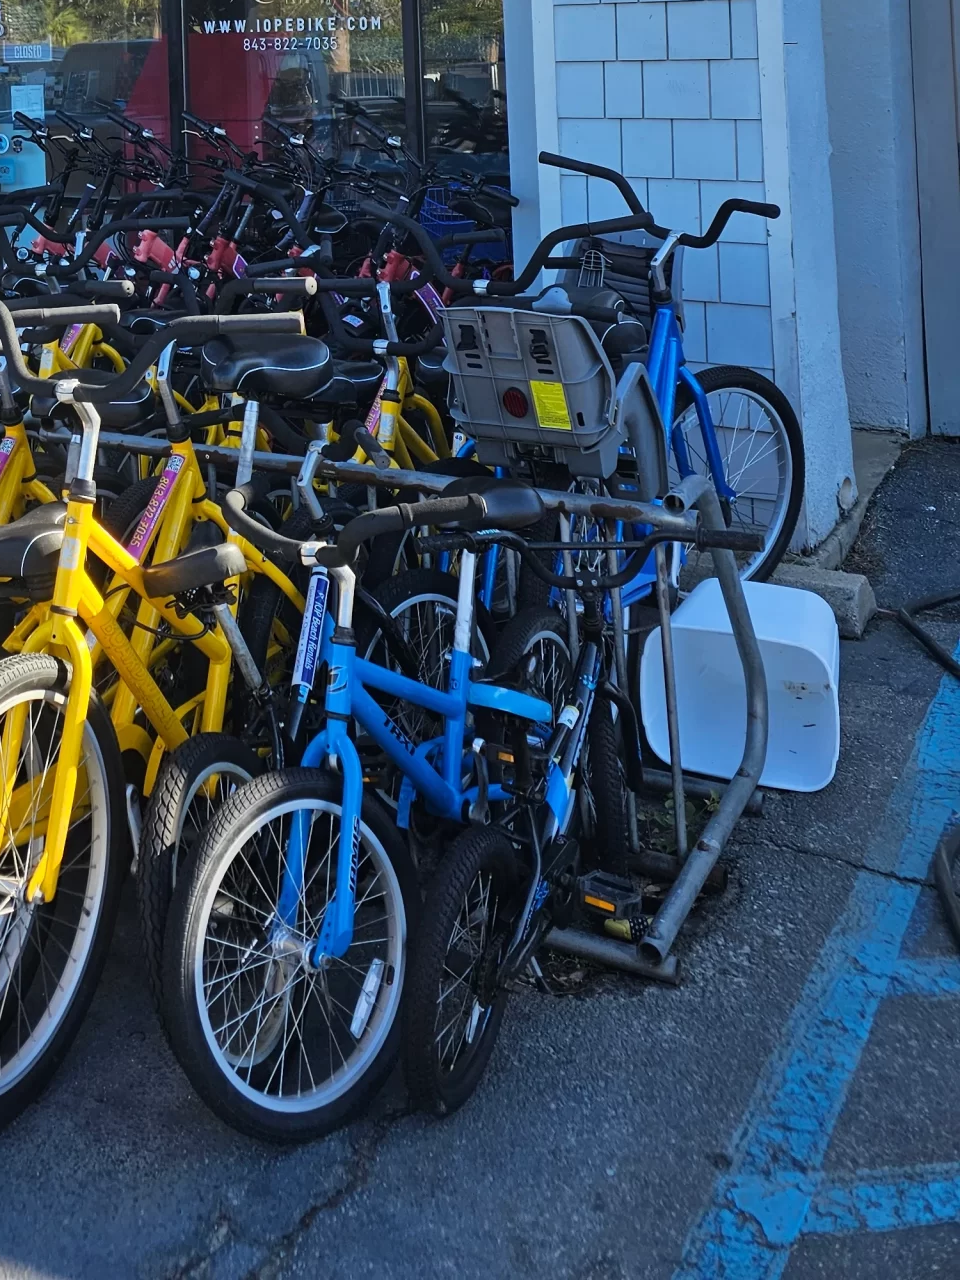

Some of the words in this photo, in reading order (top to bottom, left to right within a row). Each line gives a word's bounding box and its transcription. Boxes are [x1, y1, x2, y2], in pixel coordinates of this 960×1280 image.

[204, 16, 382, 35] WWW.IOPEBIKE.COM
[13, 44, 43, 59] CLOSED
[242, 36, 338, 52] 843-822-7035
[130, 477, 170, 548] 843-822-7035
[310, 616, 321, 643] Beach
[305, 640, 318, 671] Rentals
